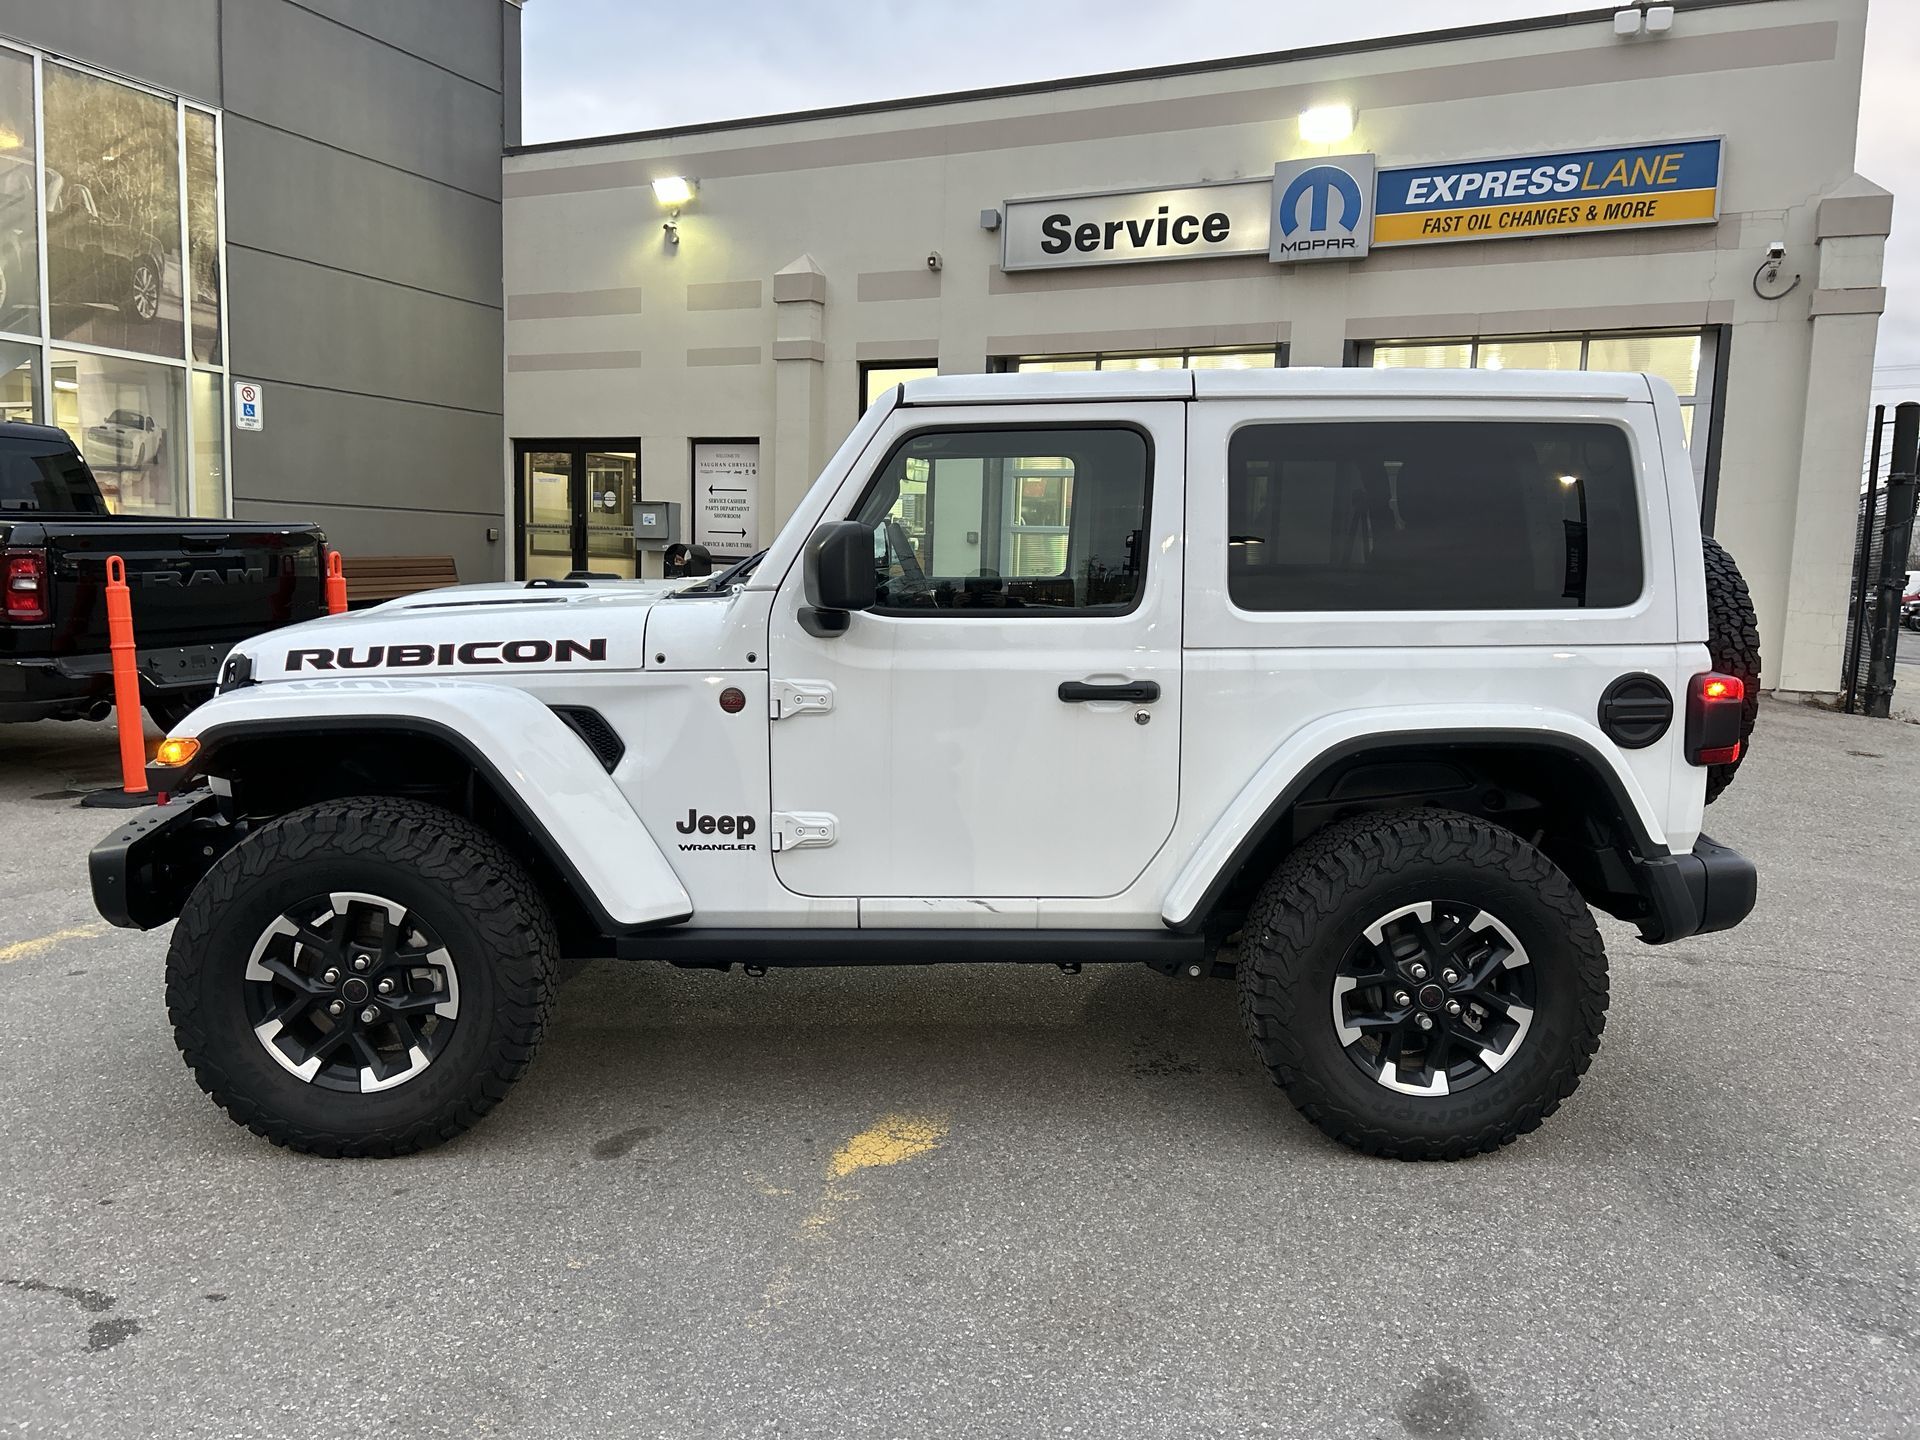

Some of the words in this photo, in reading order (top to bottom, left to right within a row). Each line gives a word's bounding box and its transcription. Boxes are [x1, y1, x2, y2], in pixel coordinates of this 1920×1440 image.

[1040, 206, 1231, 255] Service
[1422, 216, 1462, 234] FAST
[1467, 213, 1493, 231] OIL
[1499, 206, 1580, 228] CHANGES
[1585, 204, 1598, 221] &
[1603, 200, 1659, 221] MORE
[1280, 238, 1356, 253] MOPAR
[142, 567, 264, 588] RAM
[284, 638, 607, 672] RUBICON
[675, 808, 756, 840] Jeep
[678, 843, 756, 851] WRANGLER
